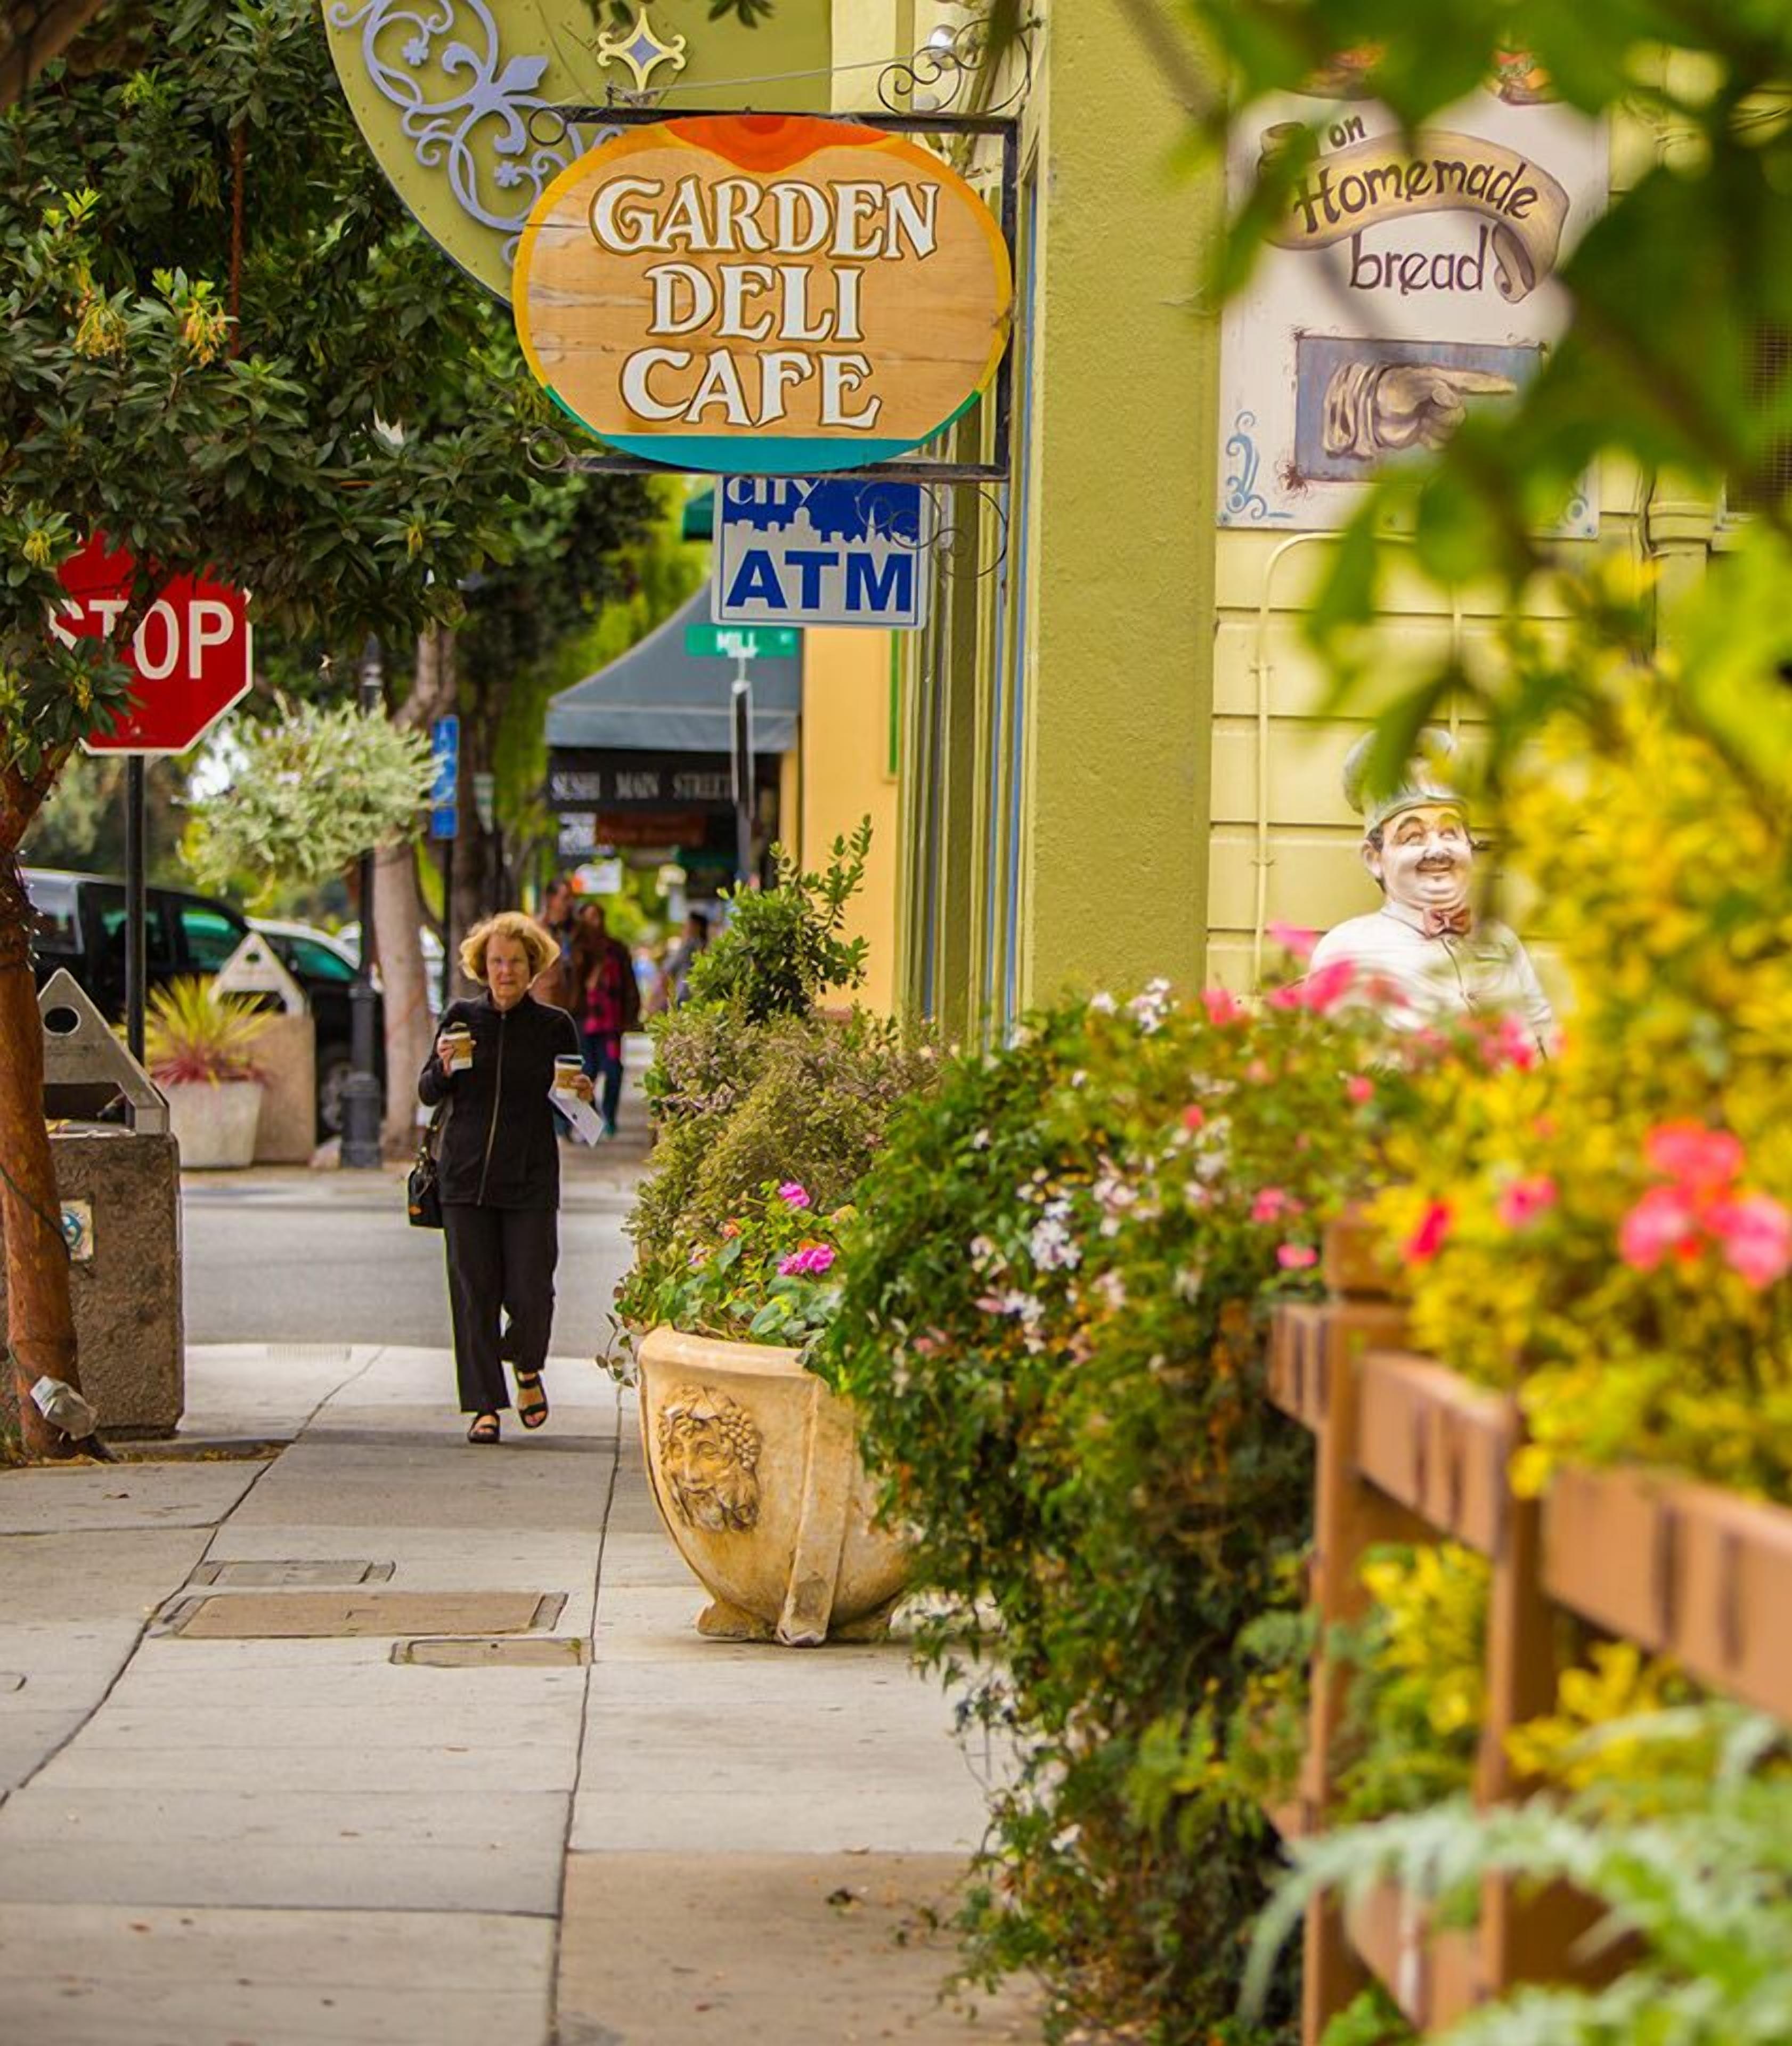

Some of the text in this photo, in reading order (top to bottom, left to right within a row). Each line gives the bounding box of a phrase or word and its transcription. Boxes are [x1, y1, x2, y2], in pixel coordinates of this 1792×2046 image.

[1328, 114, 1367, 148] on
[590, 175, 940, 259] GARDEN
[1293, 159, 1539, 234] Homemade
[1349, 224, 1489, 296] bread
[644, 262, 865, 343] DELI
[619, 346, 883, 429] CAFE
[725, 549, 913, 612] ATM
